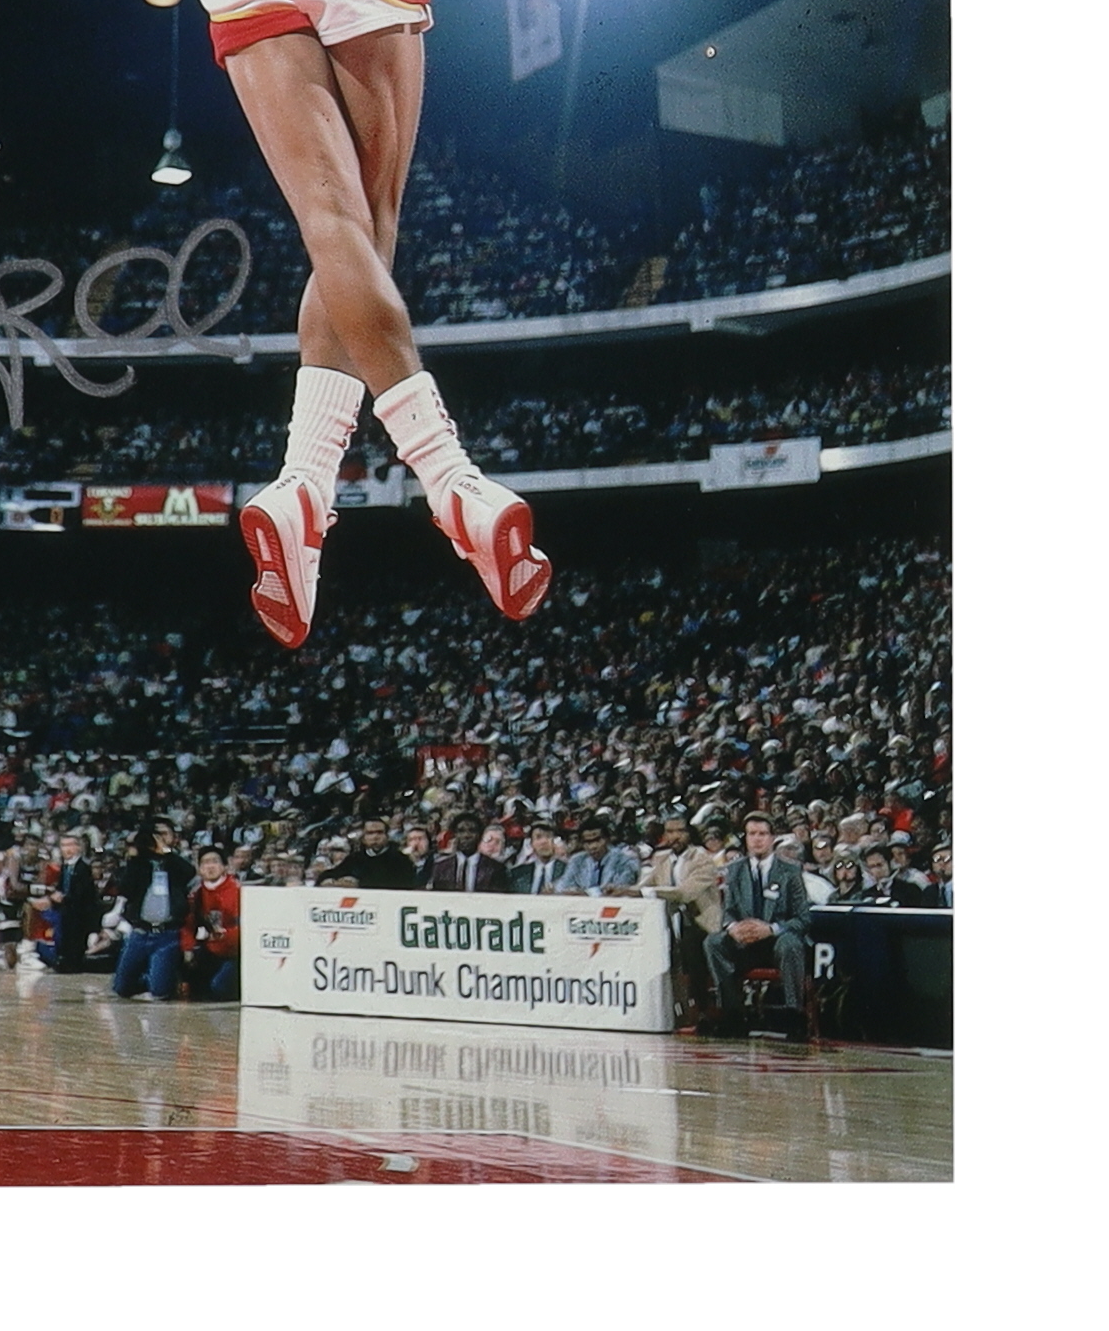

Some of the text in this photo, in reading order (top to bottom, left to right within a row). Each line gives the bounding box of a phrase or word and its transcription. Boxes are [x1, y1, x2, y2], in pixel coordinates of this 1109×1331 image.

[401, 906, 545, 955] Gatorade
[312, 955, 637, 1016] Slam-Dunk Championship
